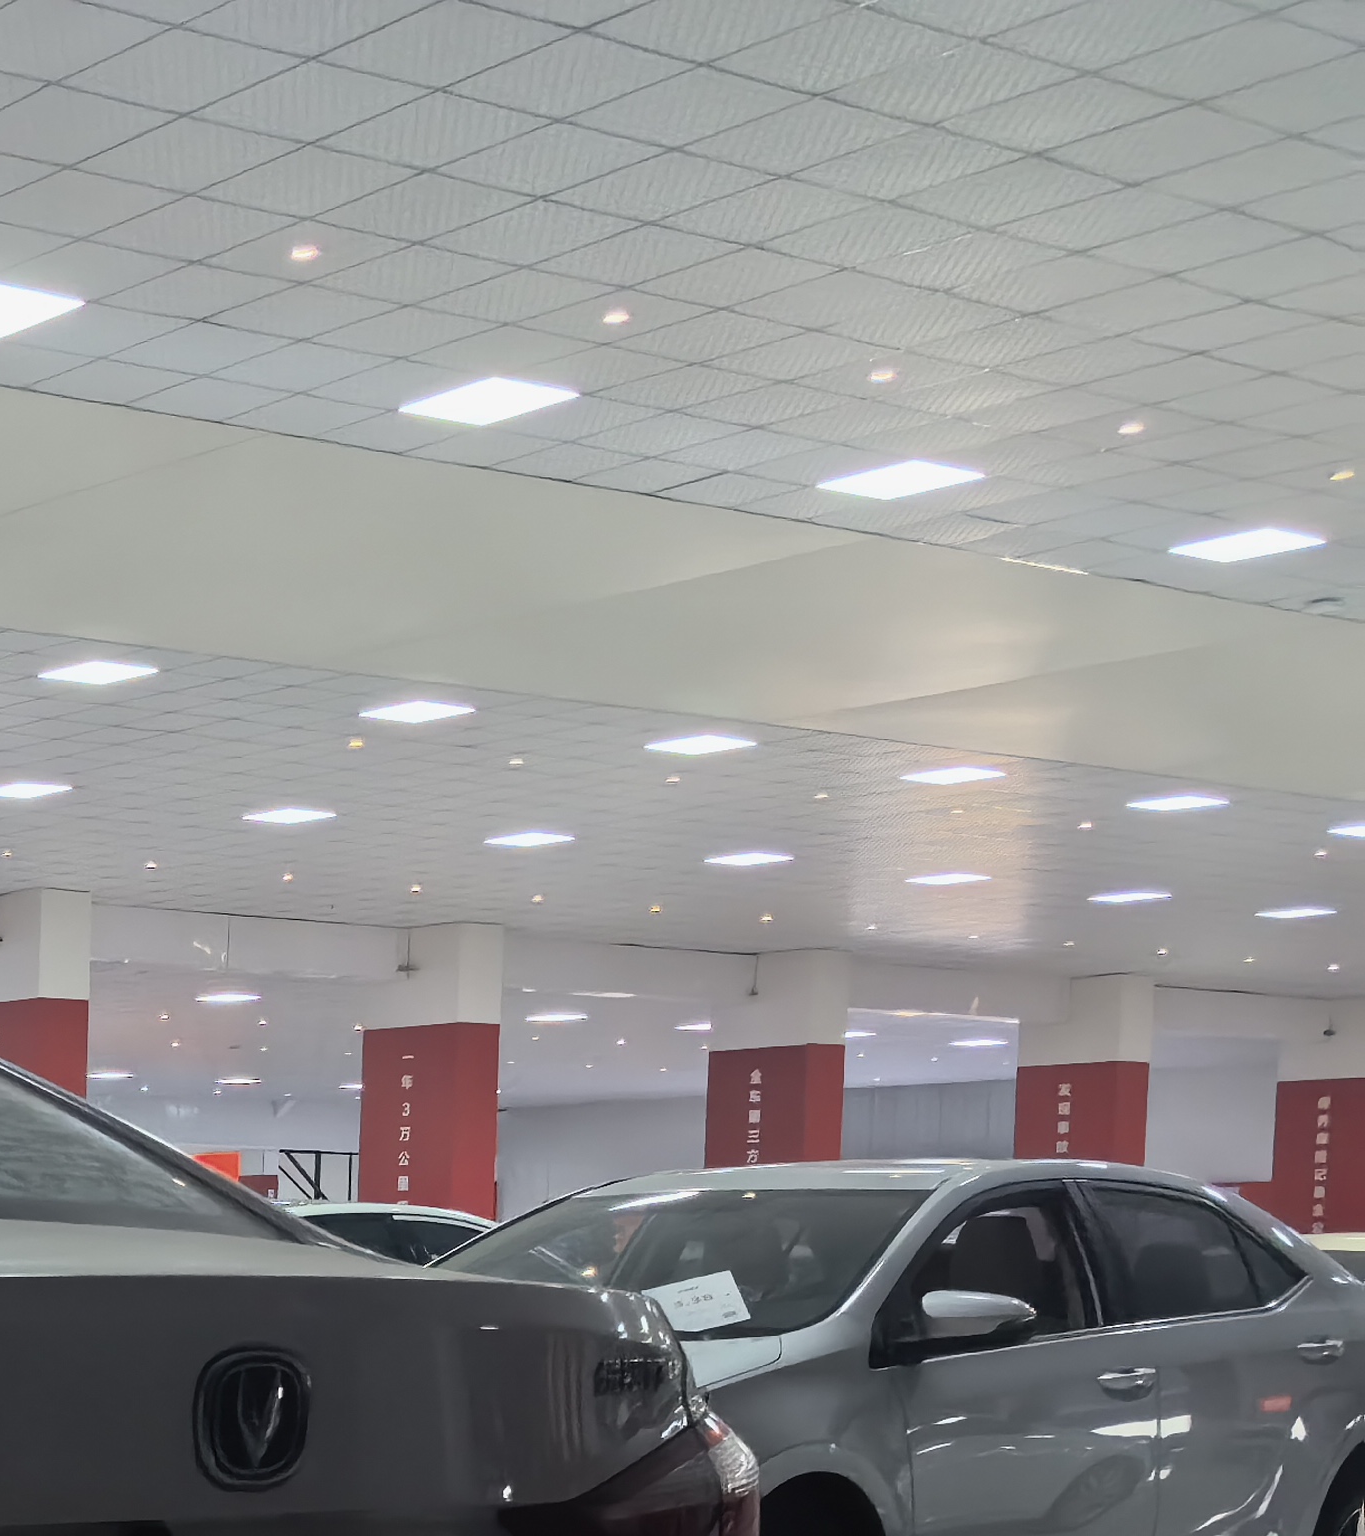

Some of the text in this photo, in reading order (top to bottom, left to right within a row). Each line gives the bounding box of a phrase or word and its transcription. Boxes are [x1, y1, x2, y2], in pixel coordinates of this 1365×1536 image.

[397, 1055, 415, 1205] 一年3万公里
